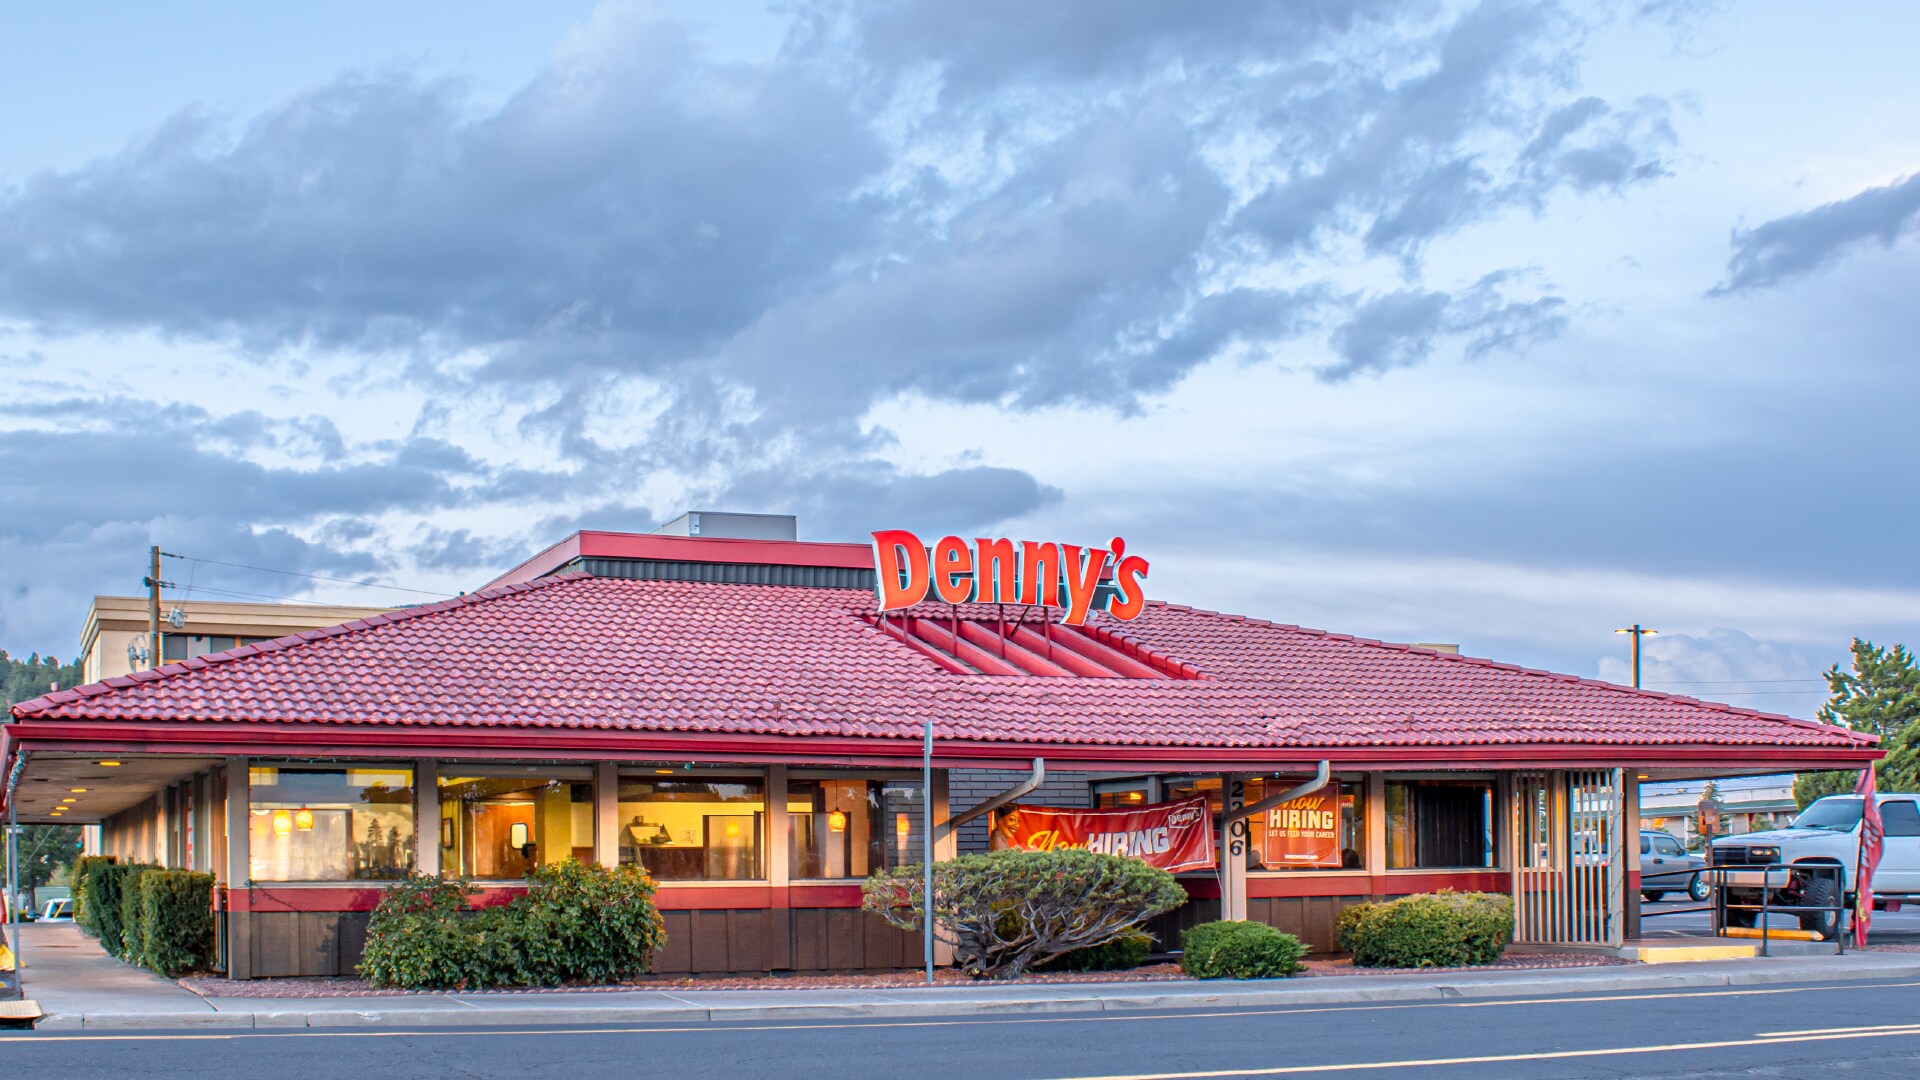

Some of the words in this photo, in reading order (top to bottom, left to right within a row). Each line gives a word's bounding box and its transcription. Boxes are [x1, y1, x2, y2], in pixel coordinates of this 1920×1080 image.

[871, 529, 1149, 626] Denny's
[1270, 809, 1333, 829] HIRING
[1088, 826, 1169, 857] HIRING
[1287, 830, 1300, 838] FEED
[1301, 830, 1314, 838] YOUR
